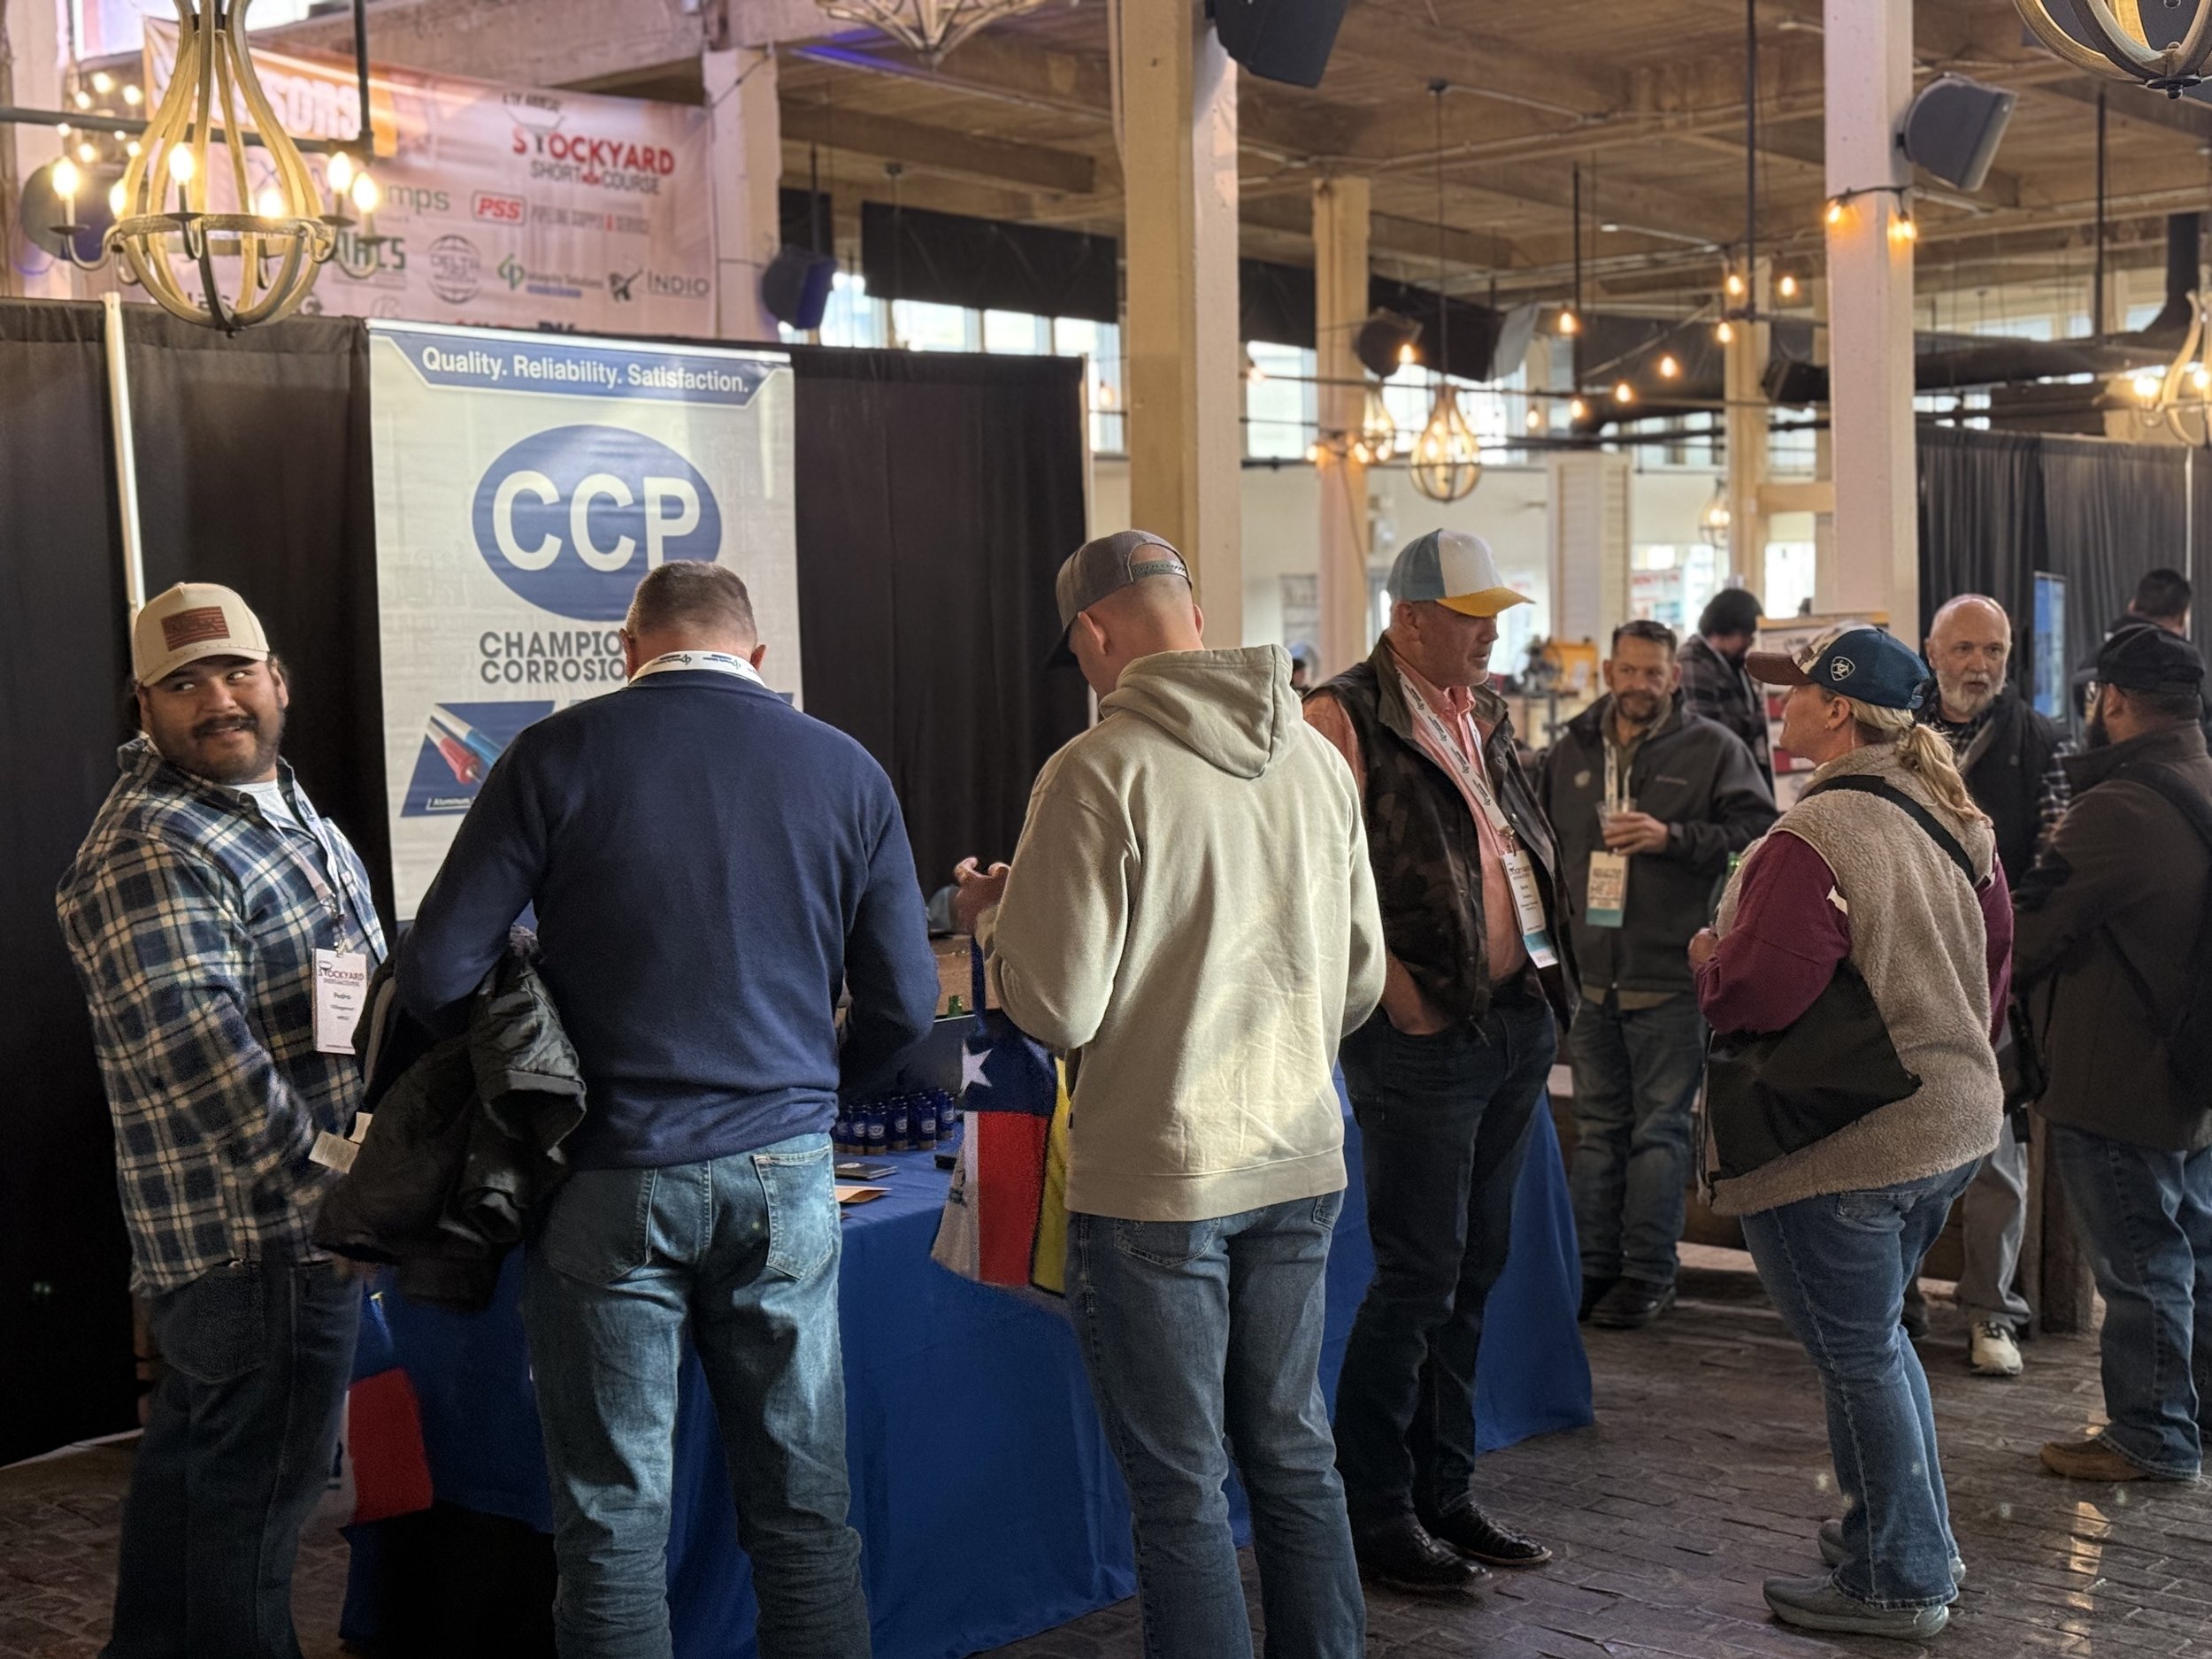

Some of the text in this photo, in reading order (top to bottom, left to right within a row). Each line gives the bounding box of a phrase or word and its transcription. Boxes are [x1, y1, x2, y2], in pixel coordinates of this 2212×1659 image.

[512, 127, 675, 175] STOCKYARD
[531, 160, 661, 195] SHORT COURSE
[478, 197, 521, 220] PSS
[647, 270, 710, 297] INDIO
[422, 347, 749, 393] Quality. Reliability. Satisfaction.
[493, 471, 700, 572] CCP
[479, 630, 623, 659] CHAMPIO
[480, 657, 627, 684] CORROSIO
